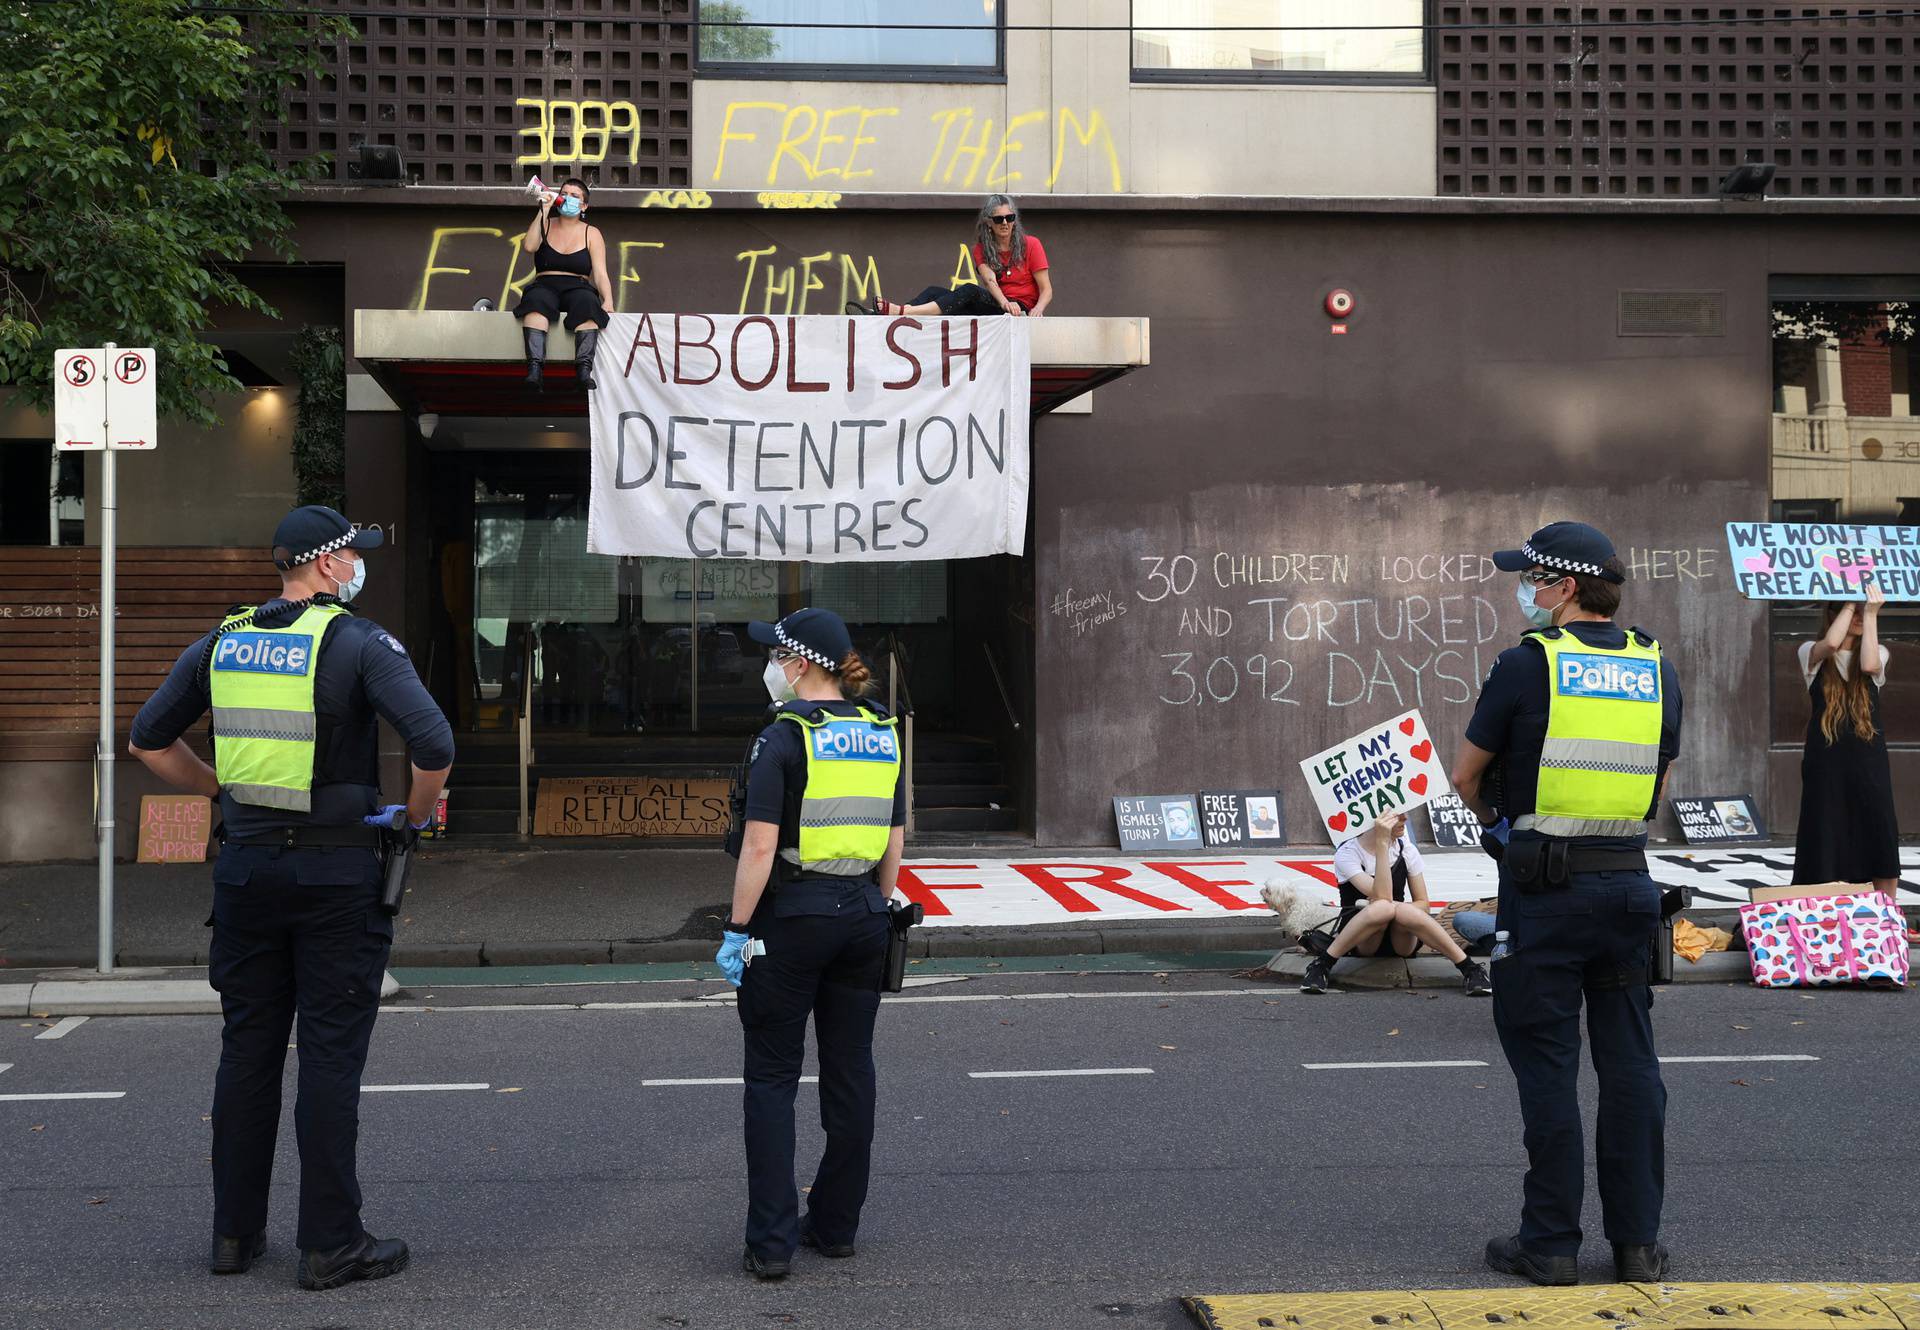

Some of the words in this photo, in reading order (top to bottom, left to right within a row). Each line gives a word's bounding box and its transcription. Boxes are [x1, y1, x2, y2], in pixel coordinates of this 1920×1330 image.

[516, 98, 641, 166] 3089
[712, 102, 900, 184] FREE
[921, 106, 1122, 193] THEM
[639, 189, 713, 209] ACAB
[737, 245, 883, 315] THEM
[624, 312, 979, 393] ABOLISH
[615, 408, 1006, 492] DETENTION
[685, 498, 930, 558] CENTRES
[1731, 524, 1776, 547] WE
[1784, 525, 1867, 546] WONT
[1761, 548, 1815, 569] YOU
[1137, 556, 1198, 601] 30
[1213, 552, 1350, 588] CHILDREN
[1381, 554, 1497, 583] LOCKED
[1626, 547, 1719, 582] HERE
[1740, 571, 1803, 597] FREE
[1807, 571, 1857, 595] ALL
[1069, 603, 1127, 637] friends
[1178, 608, 1232, 637] AND
[1248, 595, 1498, 648] TORTURED
[218, 638, 306, 668] Police
[1159, 651, 1300, 706] 3,092
[1562, 660, 1655, 694] Police
[815, 727, 894, 755] Police
[1314, 750, 1349, 786] LET
[1357, 729, 1391, 762] MY
[583, 785, 638, 796] FREE
[650, 783, 700, 798] ALL
[1332, 752, 1404, 804] FRIENDS
[146, 800, 207, 823] RELEASE
[1120, 802, 1131, 813] IS
[1136, 800, 1146, 812] IT
[1203, 795, 1239, 812] FREE
[1347, 775, 1406, 828] STAY
[1676, 801, 1703, 813] HOW
[149, 822, 199, 841] SETTLE
[554, 822, 583, 834] END
[593, 821, 683, 834] TEMPORARY
[1207, 811, 1239, 827] JOY
[1680, 811, 1711, 825] LONG
[1208, 827, 1242, 845] NOW
[1683, 825, 1727, 839] HOSSEIN
[144, 839, 207, 860] SUPPORT
